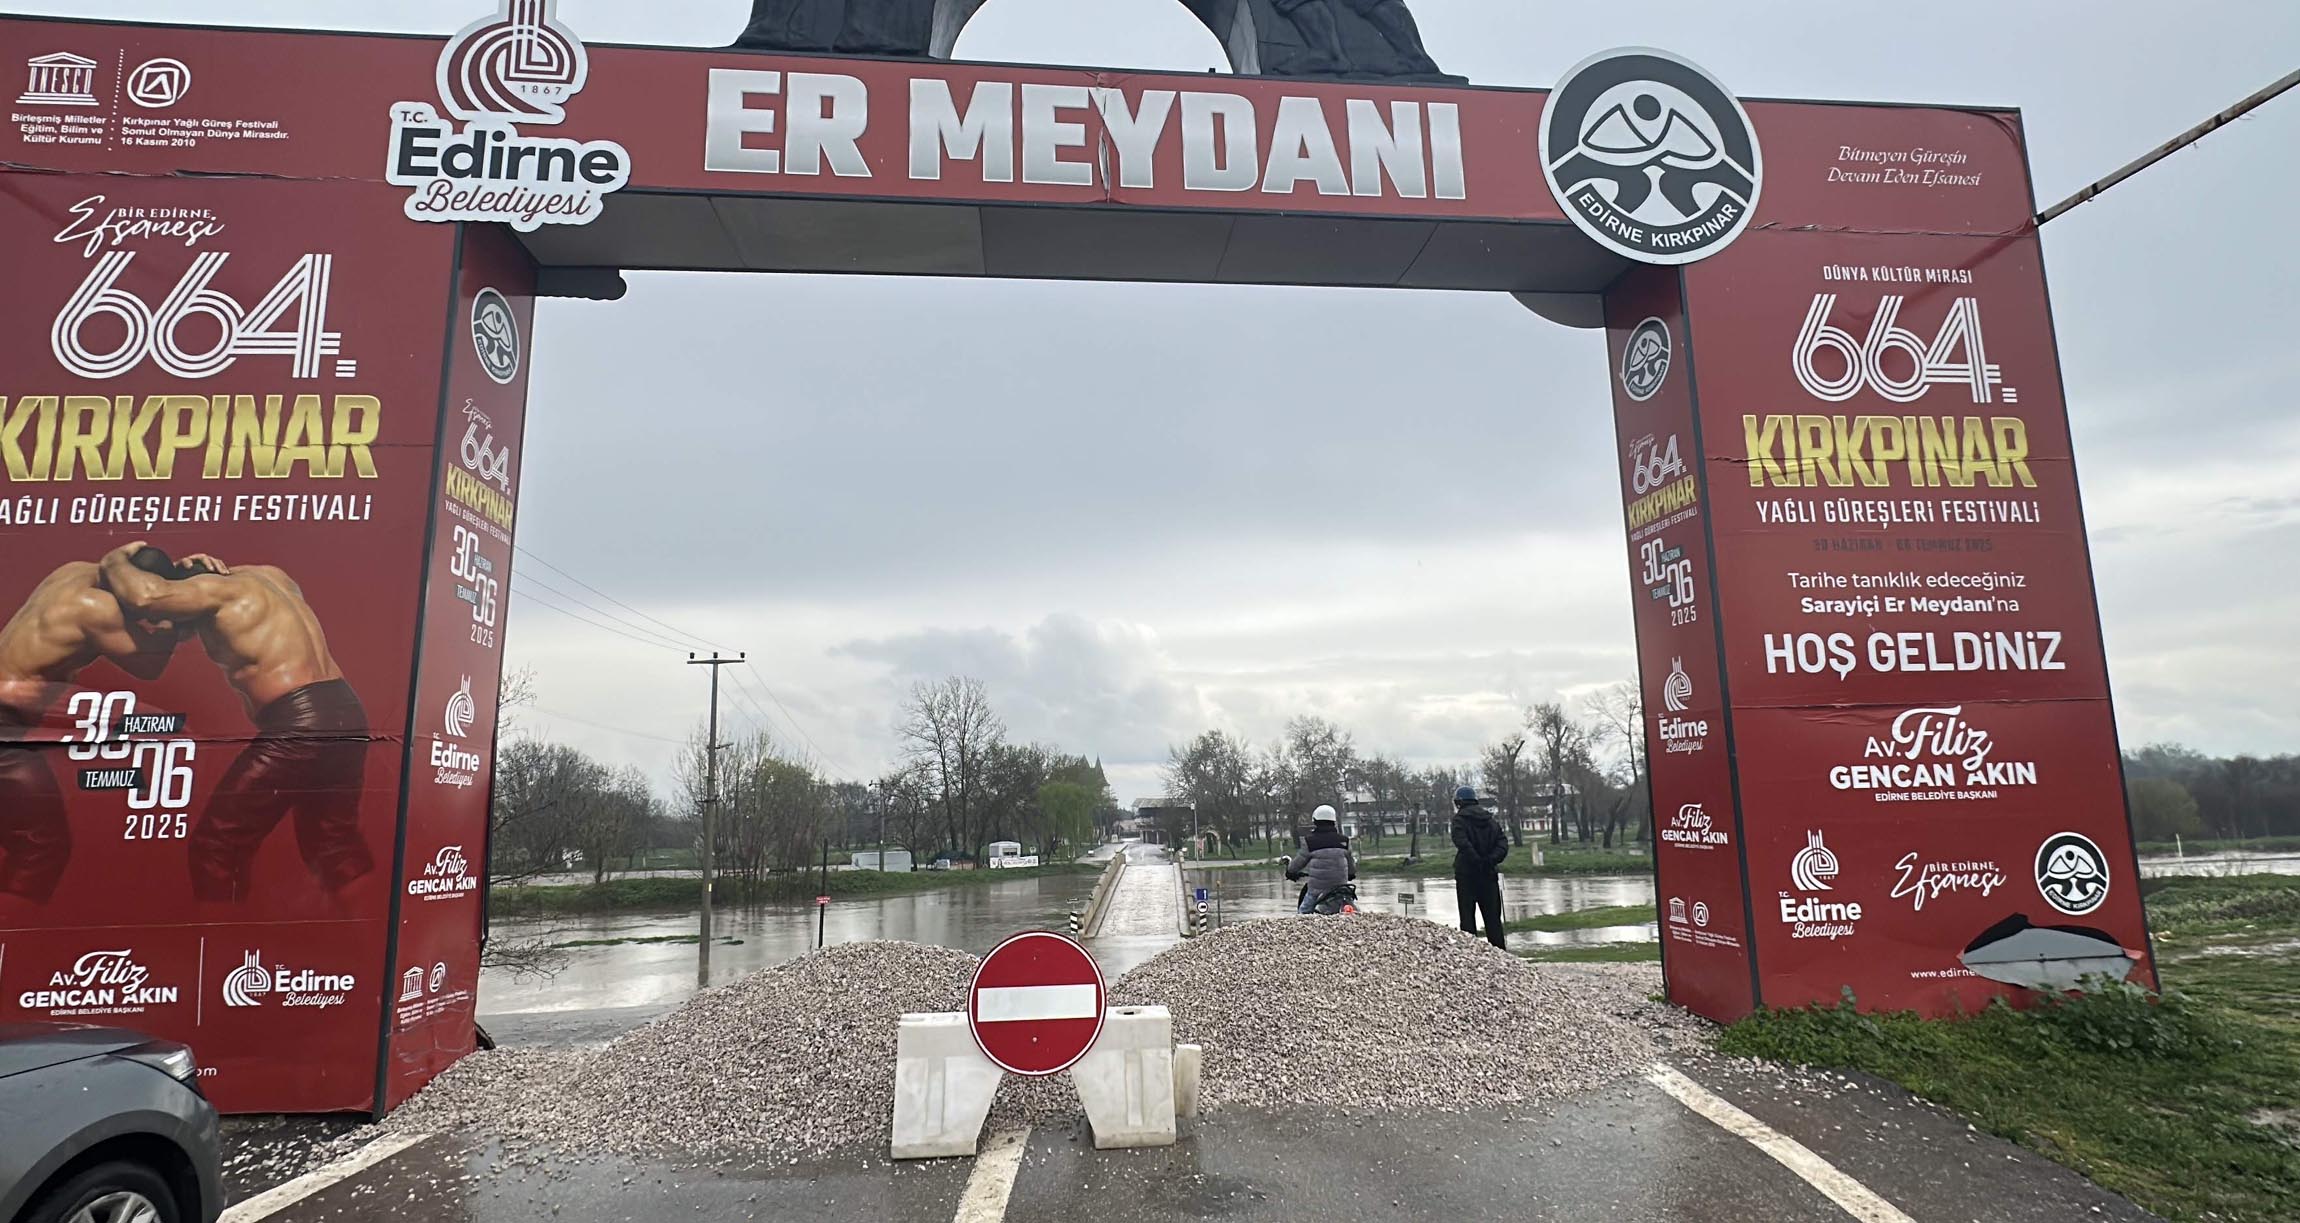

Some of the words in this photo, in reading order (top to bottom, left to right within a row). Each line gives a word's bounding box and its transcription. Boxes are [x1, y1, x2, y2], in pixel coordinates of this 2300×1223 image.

[28, 66, 93, 94] UNESCO
[521, 84, 563, 95] 1867
[11, 113, 61, 124] Birleşmiş
[64, 115, 107, 124] Milletler
[122, 117, 171, 127] Kırkpınar
[173, 118, 199, 128] Yağlı
[201, 119, 232, 129] Güreş
[235, 120, 279, 129] Festivali
[400, 110, 428, 123] T.C.
[23, 134, 56, 143] Kültür
[59, 135, 102, 144] Kurumu
[61, 125, 88, 134] Bilim
[121, 127, 156, 135] Somut
[158, 128, 204, 137] Olmayan
[207, 129, 240, 139] Dünya
[704, 67, 872, 177] ER
[908, 77, 1466, 200] MEYDANI
[121, 137, 133, 145] 16
[136, 137, 168, 146] Kasım
[171, 138, 196, 147] 2010
[397, 127, 619, 184] Edirne
[1838, 146, 1908, 165] Bitmeyen
[1910, 147, 1967, 166] Güreşin
[1827, 167, 1880, 183] Devam
[1883, 168, 1919, 185] Eden
[1922, 169, 1982, 188] Efsanesi
[118, 206, 145, 218] BİR
[150, 207, 212, 219] EDİRNE
[415, 179, 592, 222] Belediyesi
[1578, 192, 1643, 243] EDİRNE
[1651, 203, 1738, 248] KIRKPINAR
[1823, 264, 1868, 282] DÜNYA
[1872, 264, 1922, 283] KÜLTÜR
[1926, 268, 1973, 284] MİRASI
[51, 251, 357, 379] 664.
[1792, 293, 2018, 403] 664.
[0, 394, 381, 481] KIRKPINAR
[1743, 414, 2038, 488] KIRKPINAR
[445, 462, 513, 533] KIRKPINAR
[1627, 474, 1697, 531] KIRKPINAR
[0, 495, 59, 525] AĞLI
[70, 493, 222, 531] GÜREŞLERİ
[233, 494, 372, 521] FESTİVALİ
[1756, 498, 1817, 523] YAĞLI
[1824, 497, 1933, 529] GÜREŞLERİ
[1941, 500, 2041, 523] FESTİVALİ
[1788, 572, 1847, 588] Tarihe
[1851, 571, 1922, 588] tanıklık
[1926, 571, 2026, 591] edeceğiniz
[1671, 605, 1697, 627] 2025
[1801, 596, 1880, 617] Sarayiçi
[1885, 597, 1905, 613] Er
[470, 623, 494, 648] 2025
[1763, 632, 1856, 681] HOŞ
[1867, 631, 2066, 672] GELDİNİZ
[60, 691, 136, 760] 30
[124, 716, 175, 733] HAZİRAN
[1658, 717, 1708, 740] Edirne
[1864, 736, 1901, 758] Av.
[1891, 705, 1993, 771] Filiz
[431, 740, 480, 771] Edirne
[85, 770, 136, 788] TEMMUZ
[127, 738, 196, 809] 06
[1829, 763, 1956, 789] GENCAN
[1966, 762, 2037, 786] AKIN
[1875, 790, 1909, 802] EDİRNE
[1911, 789, 1955, 801] BELEDİYE
[1957, 790, 1997, 801] BAŞKANI
[124, 813, 188, 840] 2025
[1679, 803, 1712, 835] Filiz
[1661, 829, 1699, 843] GENCAN
[1702, 831, 1729, 844] AKIN
[424, 862, 438, 875] Av.
[436, 845, 468, 882] Filiz
[1929, 862, 1949, 872] BİR
[1951, 861, 1995, 872] EDİRNE
[408, 878, 453, 895] GENCAN
[456, 876, 477, 891] AKIN
[1780, 897, 1862, 923] Edirne
[1791, 921, 1855, 940] Belediyesi
[49, 971, 78, 986] Av.
[73, 949, 149, 994] Filiz
[275, 969, 355, 992] Edirne
[1911, 968, 1976, 979] www.edirne
[19, 989, 115, 1008] GENCAN
[122, 987, 178, 1004] AKIN
[282, 991, 345, 1009] Belediyesi
